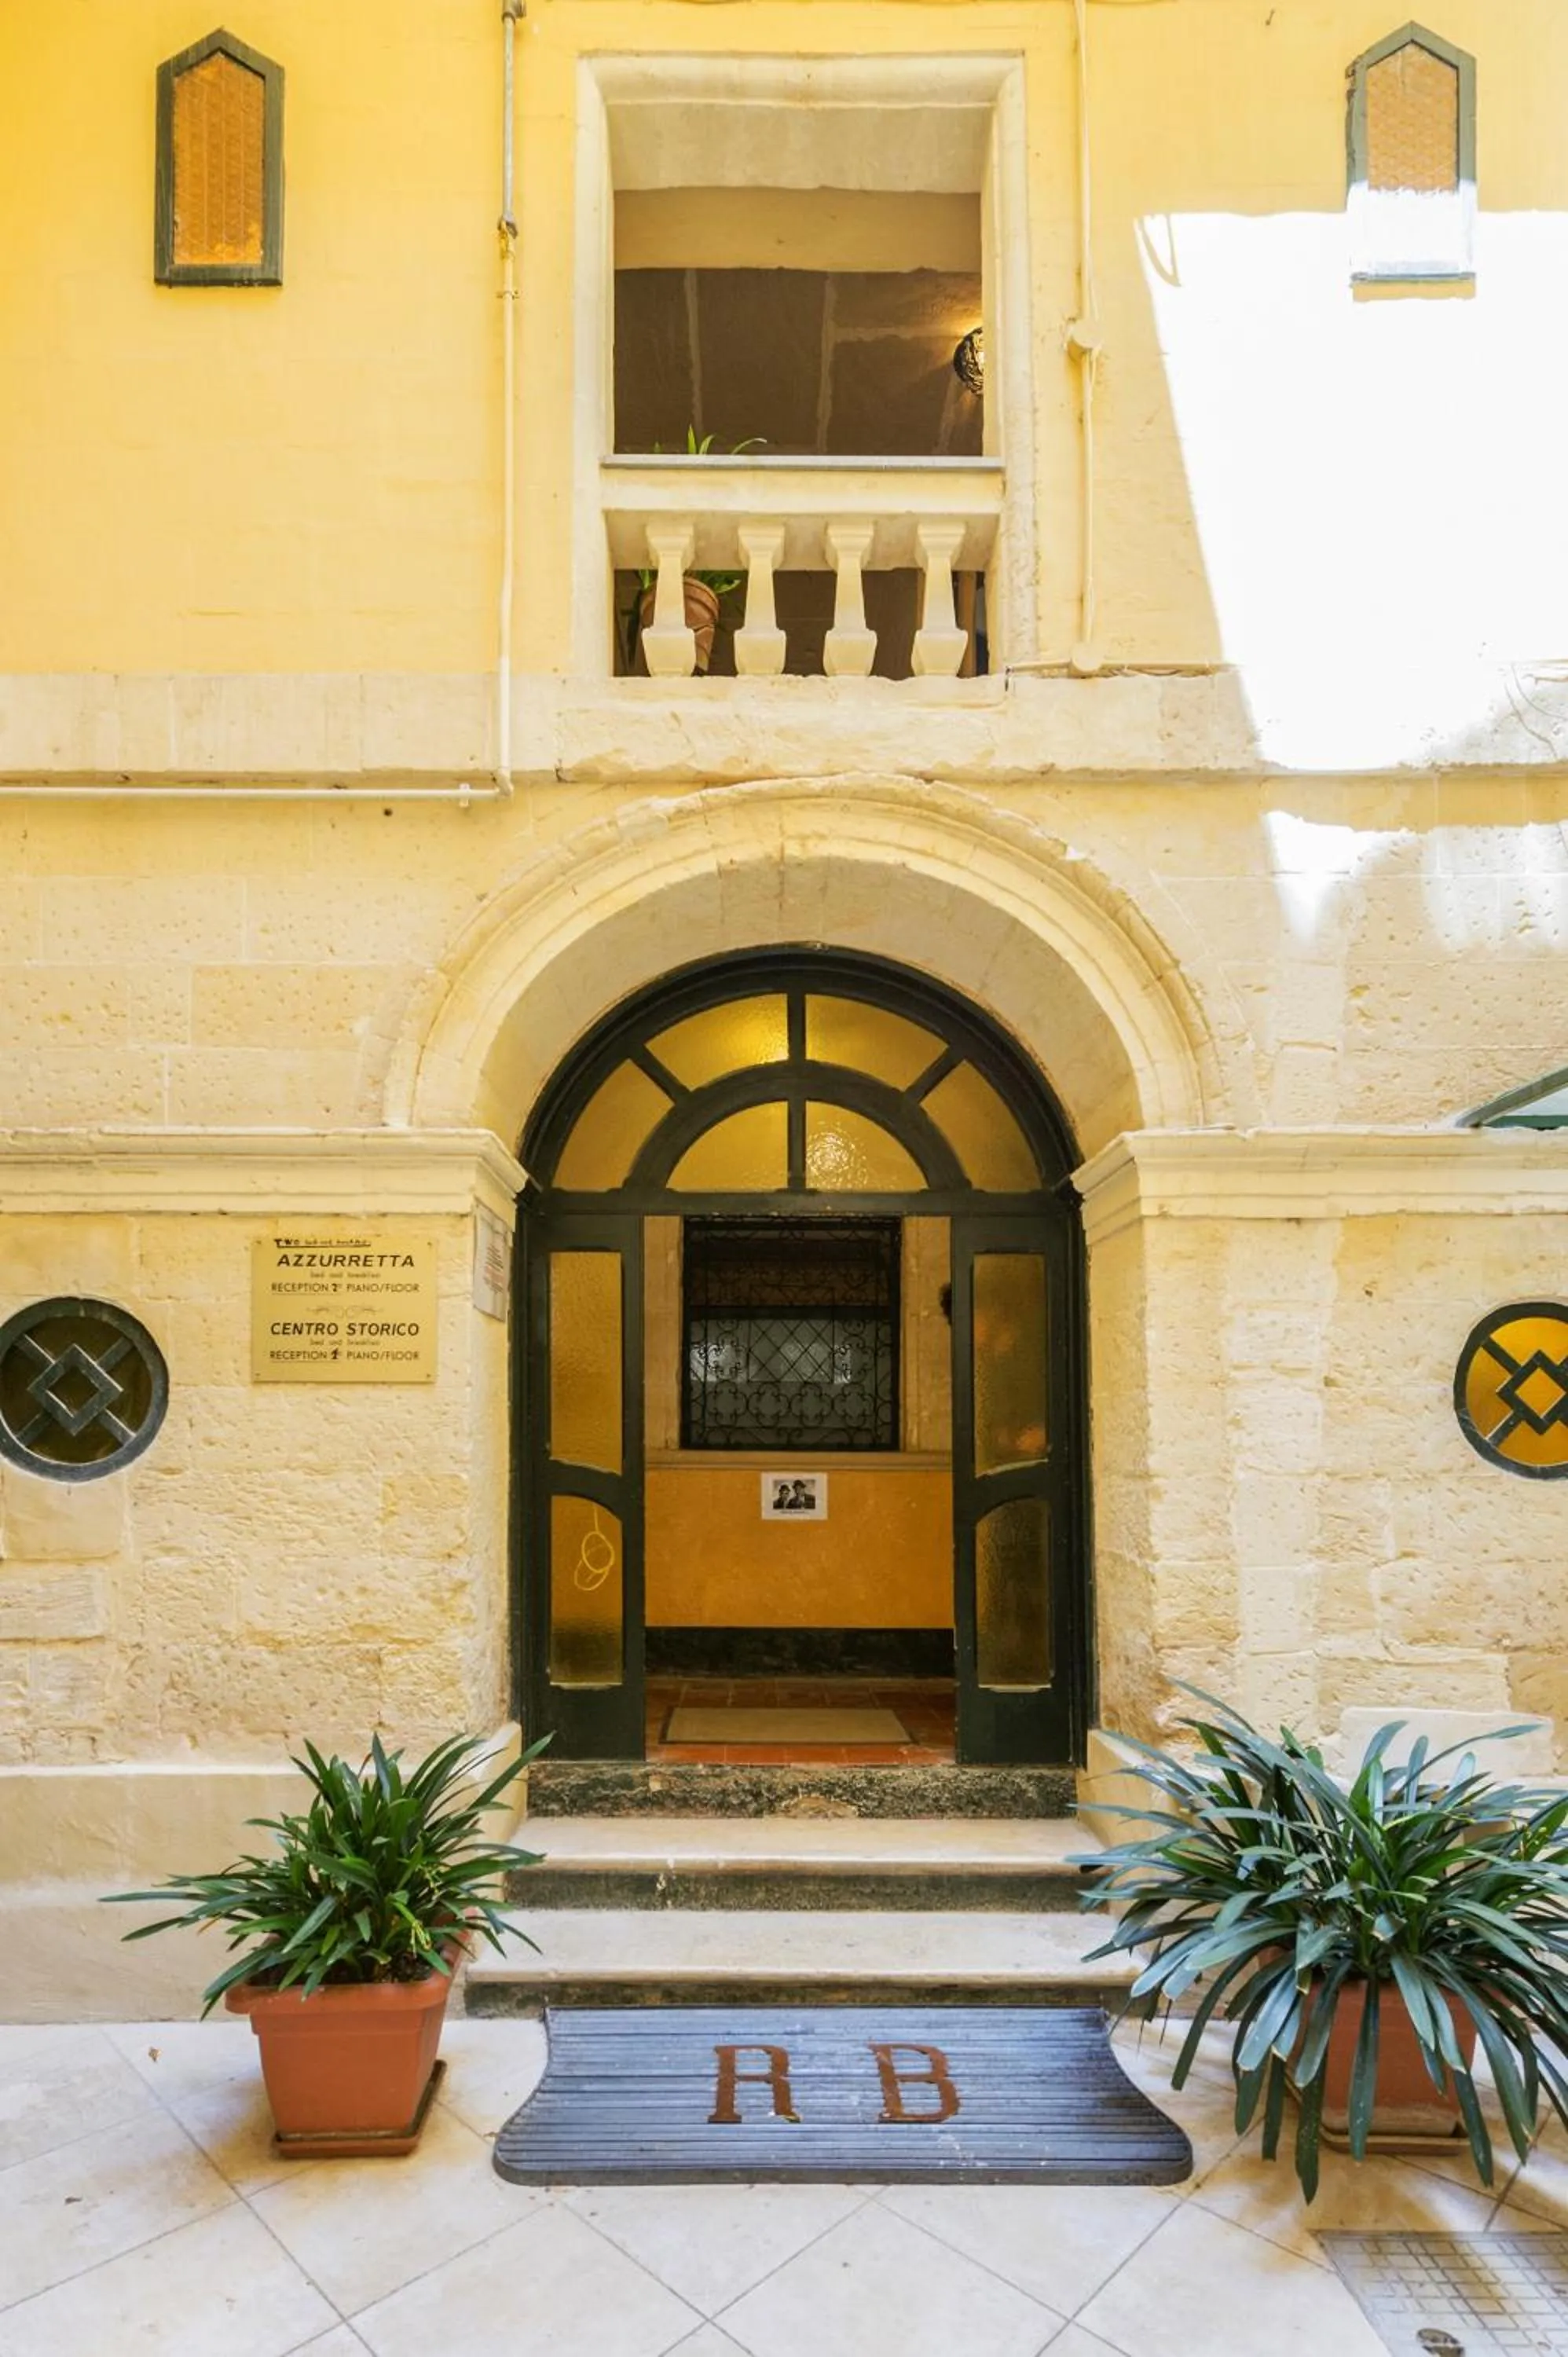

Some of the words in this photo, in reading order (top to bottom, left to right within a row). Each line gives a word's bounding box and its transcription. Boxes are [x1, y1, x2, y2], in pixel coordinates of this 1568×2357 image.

[277, 1254, 415, 1267] AZZURRETTA
[271, 1283, 328, 1292] RECEPTION
[346, 1283, 420, 1292] PIANO/FLOOR
[270, 1322, 339, 1336] CENTRO
[346, 1322, 419, 1336] STORICO
[269, 1351, 327, 1360] RECEPTION
[346, 1351, 419, 1360] PIANO/FLOOR
[706, 2043, 802, 2124] R
[868, 2043, 962, 2124] B
